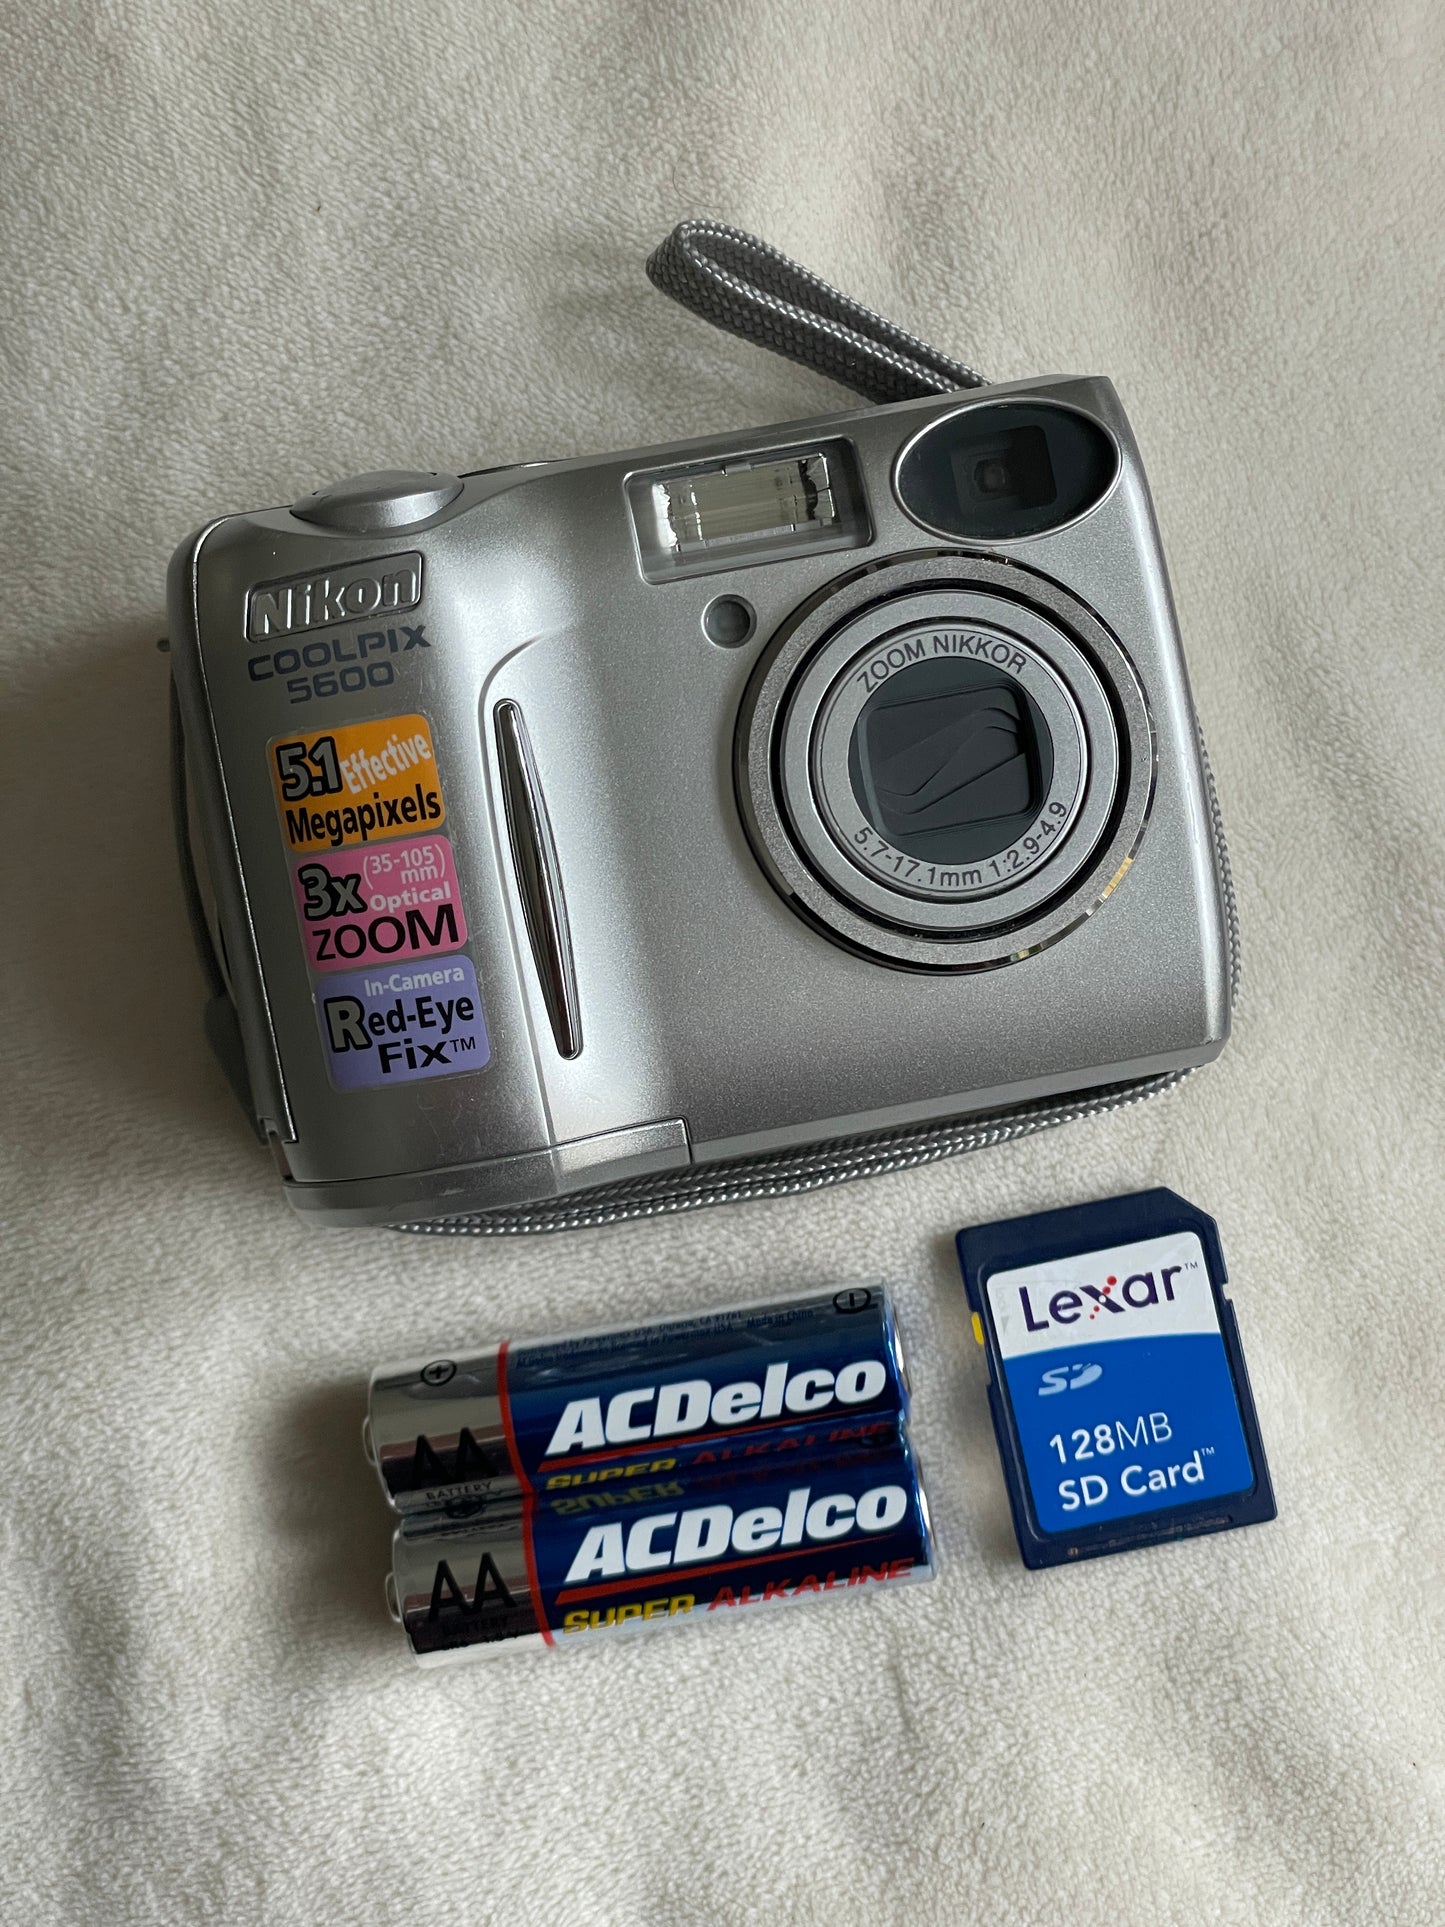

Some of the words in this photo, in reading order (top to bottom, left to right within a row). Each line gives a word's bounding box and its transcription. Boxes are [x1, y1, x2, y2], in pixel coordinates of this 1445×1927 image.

[251, 568, 417, 636] Nikon
[247, 624, 431, 682] COOLPIX
[856, 639, 927, 693] ZOOM
[932, 634, 1028, 675] NIKKOR
[286, 661, 395, 704] 5600
[276, 736, 343, 802] 5.1
[340, 733, 432, 794] Effective
[285, 783, 441, 848] Megapixels
[854, 826, 983, 887] 5.7-17.1mm
[989, 801, 1068, 878] 1:2.9-4.9
[297, 863, 368, 921] 3x
[369, 881, 451, 913] Optical
[401, 865, 437, 885] mm
[312, 903, 459, 961] ZOOM
[364, 966, 465, 998] In-Camera
[323, 994, 475, 1054] Red-Eye
[545, 1360, 886, 1457] ACDelco
[1049, 1411, 1173, 1465] 128MB
[425, 1481, 493, 1500] BATTERY
[546, 1458, 677, 1490] SUPER
[1058, 1474, 1109, 1511] SD
[564, 1485, 907, 1583] ACDelco
[429, 1551, 518, 1621] AA
[563, 1593, 696, 1634] SUPER
[707, 1557, 915, 1613] ALKALINE
